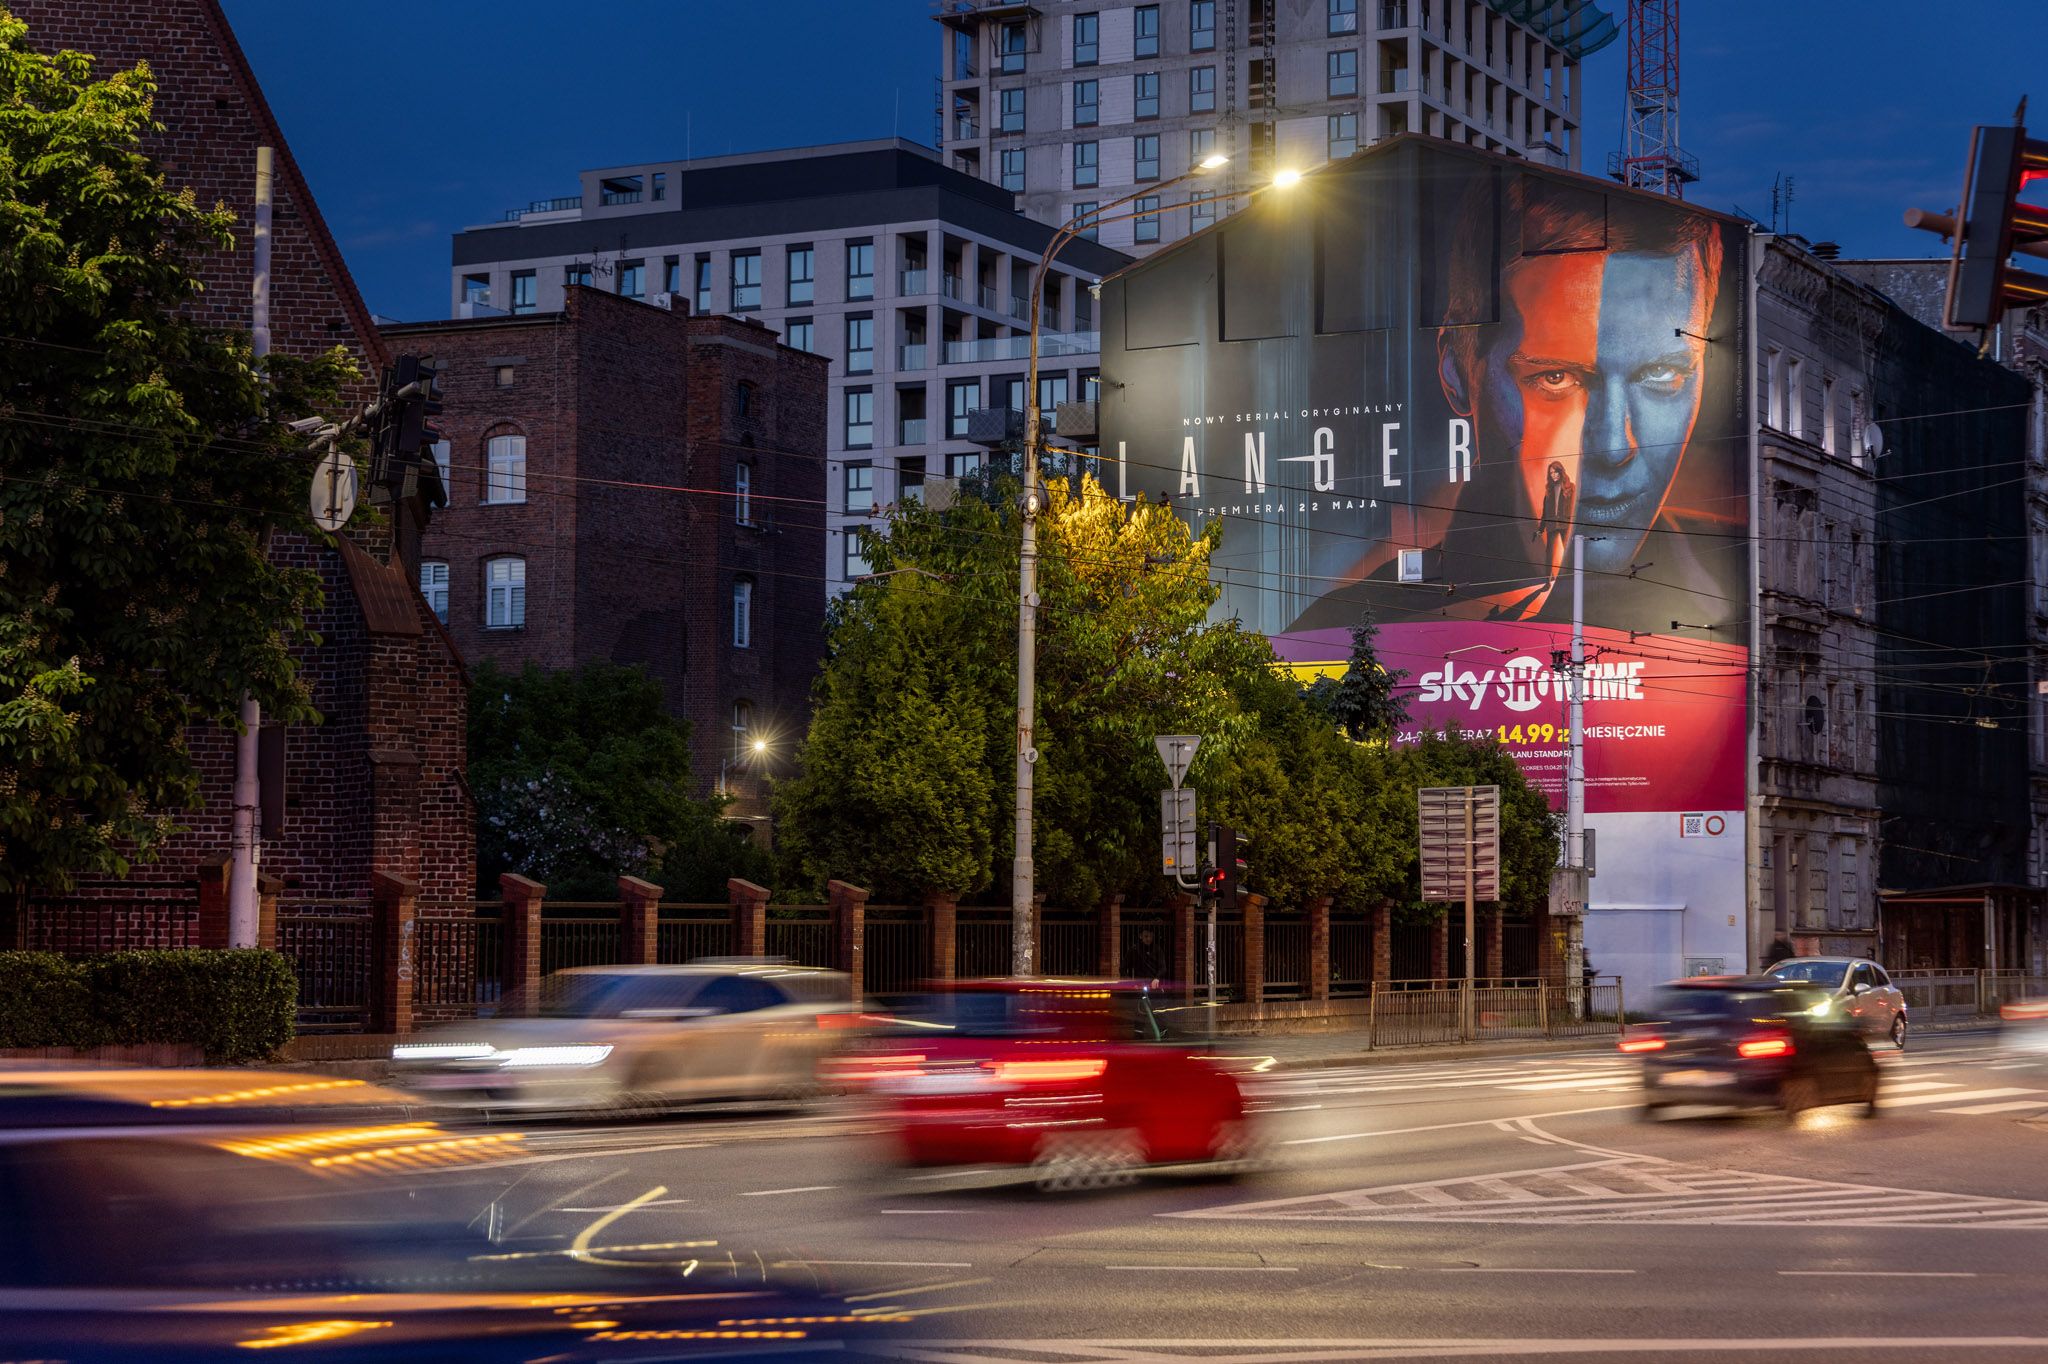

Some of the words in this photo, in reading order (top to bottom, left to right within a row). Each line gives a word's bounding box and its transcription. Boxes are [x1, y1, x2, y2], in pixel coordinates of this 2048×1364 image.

[1183, 415, 1225, 426] NOWY
[1236, 411, 1289, 422] SERIAL
[1301, 403, 1403, 418] ORYGINALNY
[1119, 419, 1472, 503] LANGER
[1197, 503, 1285, 517] PREMIERA
[1299, 502, 1319, 512] 22
[1332, 499, 1378, 510] MAJA
[1497, 723, 1555, 745] 14,99
[1582, 725, 1666, 740] MIESIĘCZNIE
